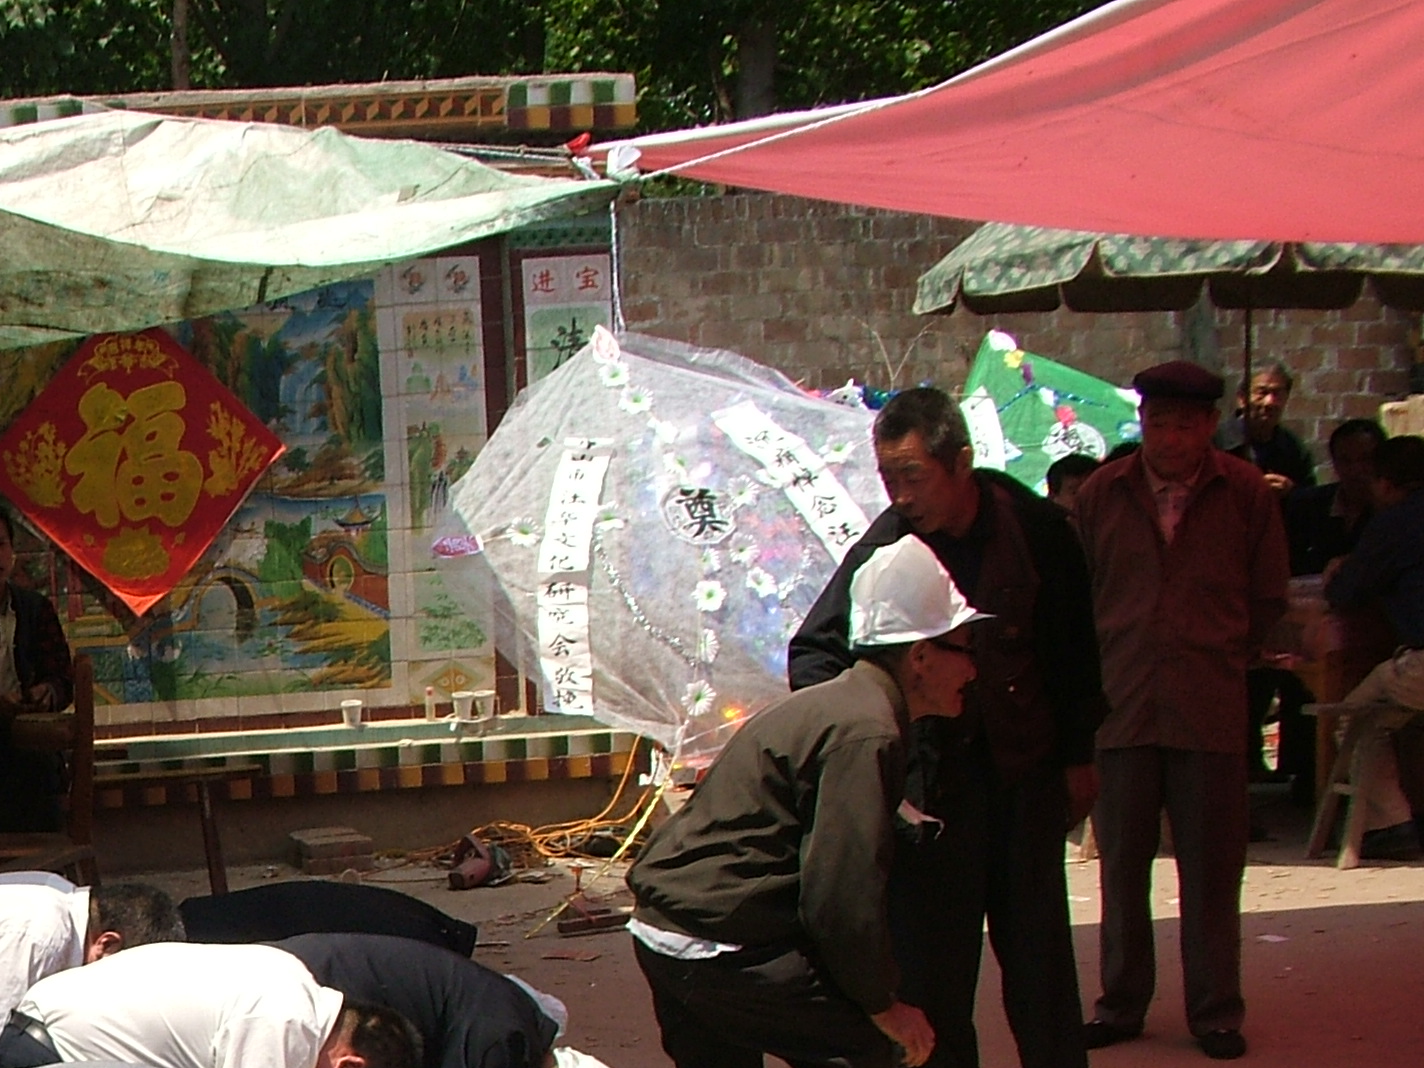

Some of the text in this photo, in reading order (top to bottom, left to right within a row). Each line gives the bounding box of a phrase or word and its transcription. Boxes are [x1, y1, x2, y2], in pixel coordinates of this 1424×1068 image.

[530, 265, 601, 294] 进宝
[64, 380, 204, 529] 福
[675, 488, 729, 538] 奠
